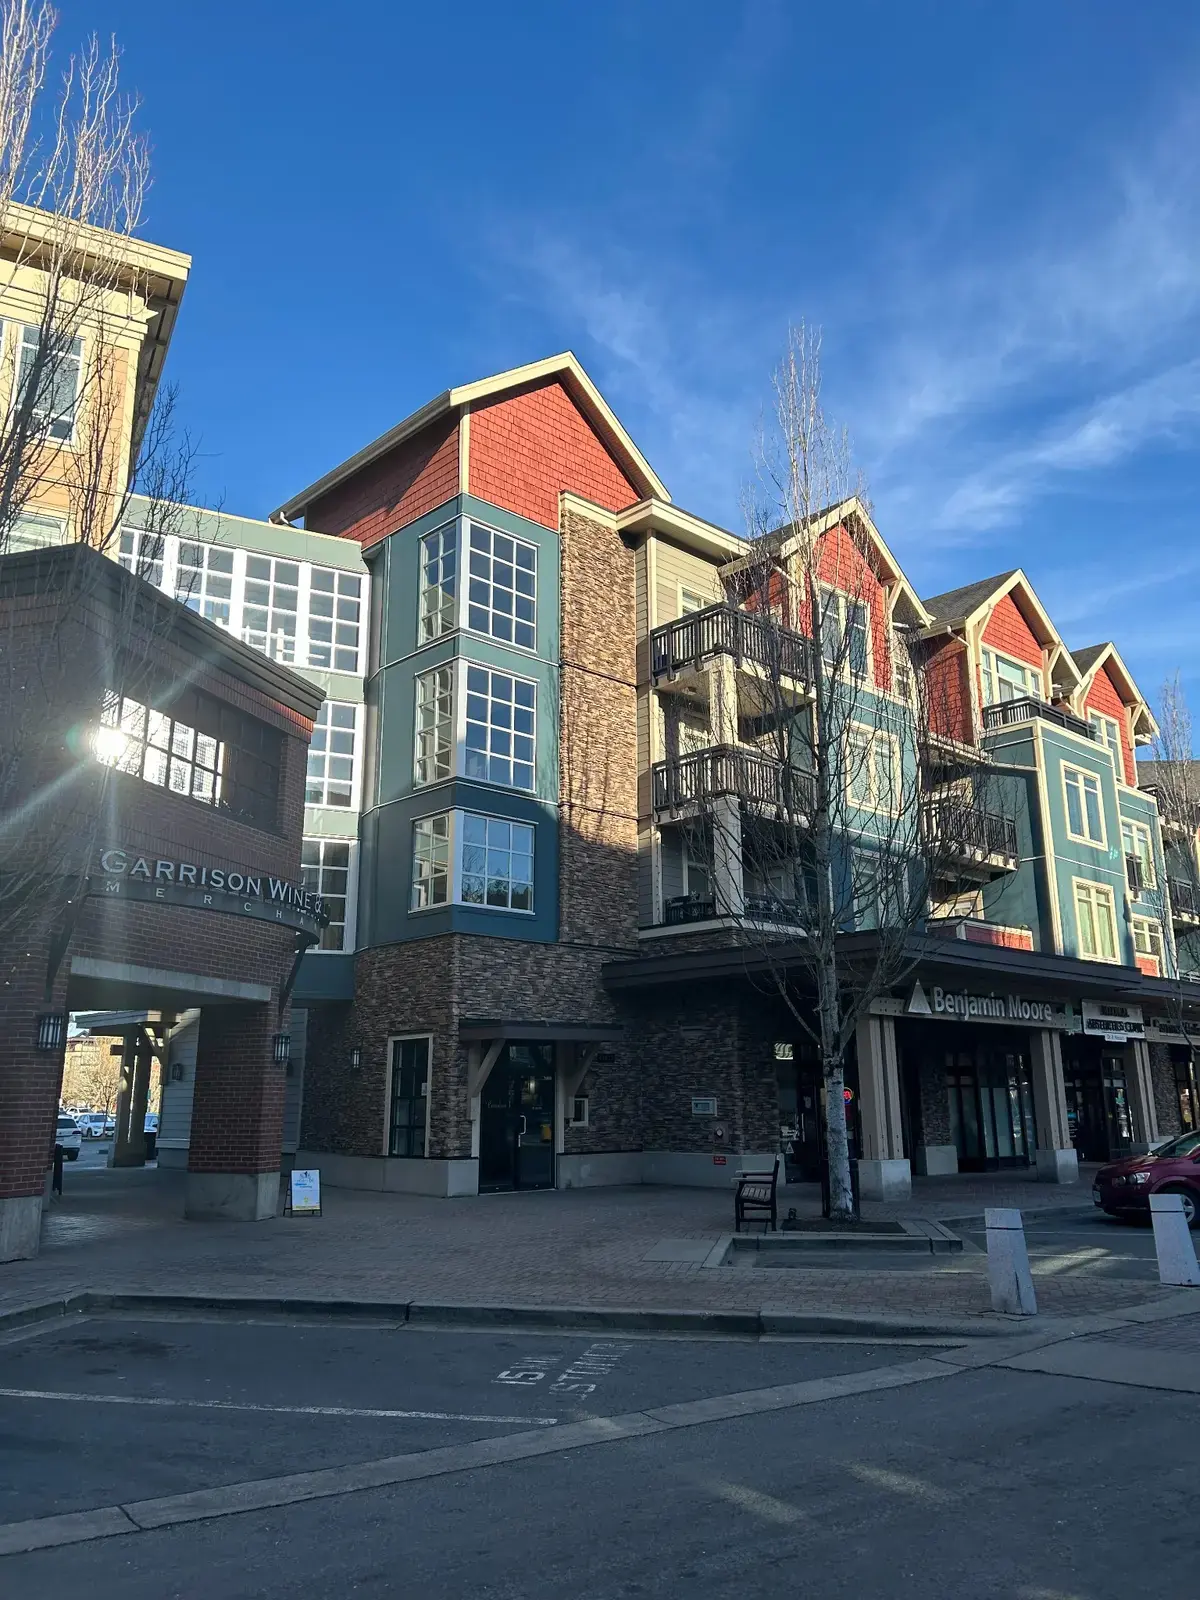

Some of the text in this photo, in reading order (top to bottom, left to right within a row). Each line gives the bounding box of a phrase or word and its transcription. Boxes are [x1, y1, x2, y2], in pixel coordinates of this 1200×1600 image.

[101, 850, 261, 896] GARRISON
[269, 877, 313, 910] WINE
[105, 880, 318, 931] MERCHA
[933, 986, 1052, 1021] Benjamin Moore
[491, 1370, 546, 1385] 15
